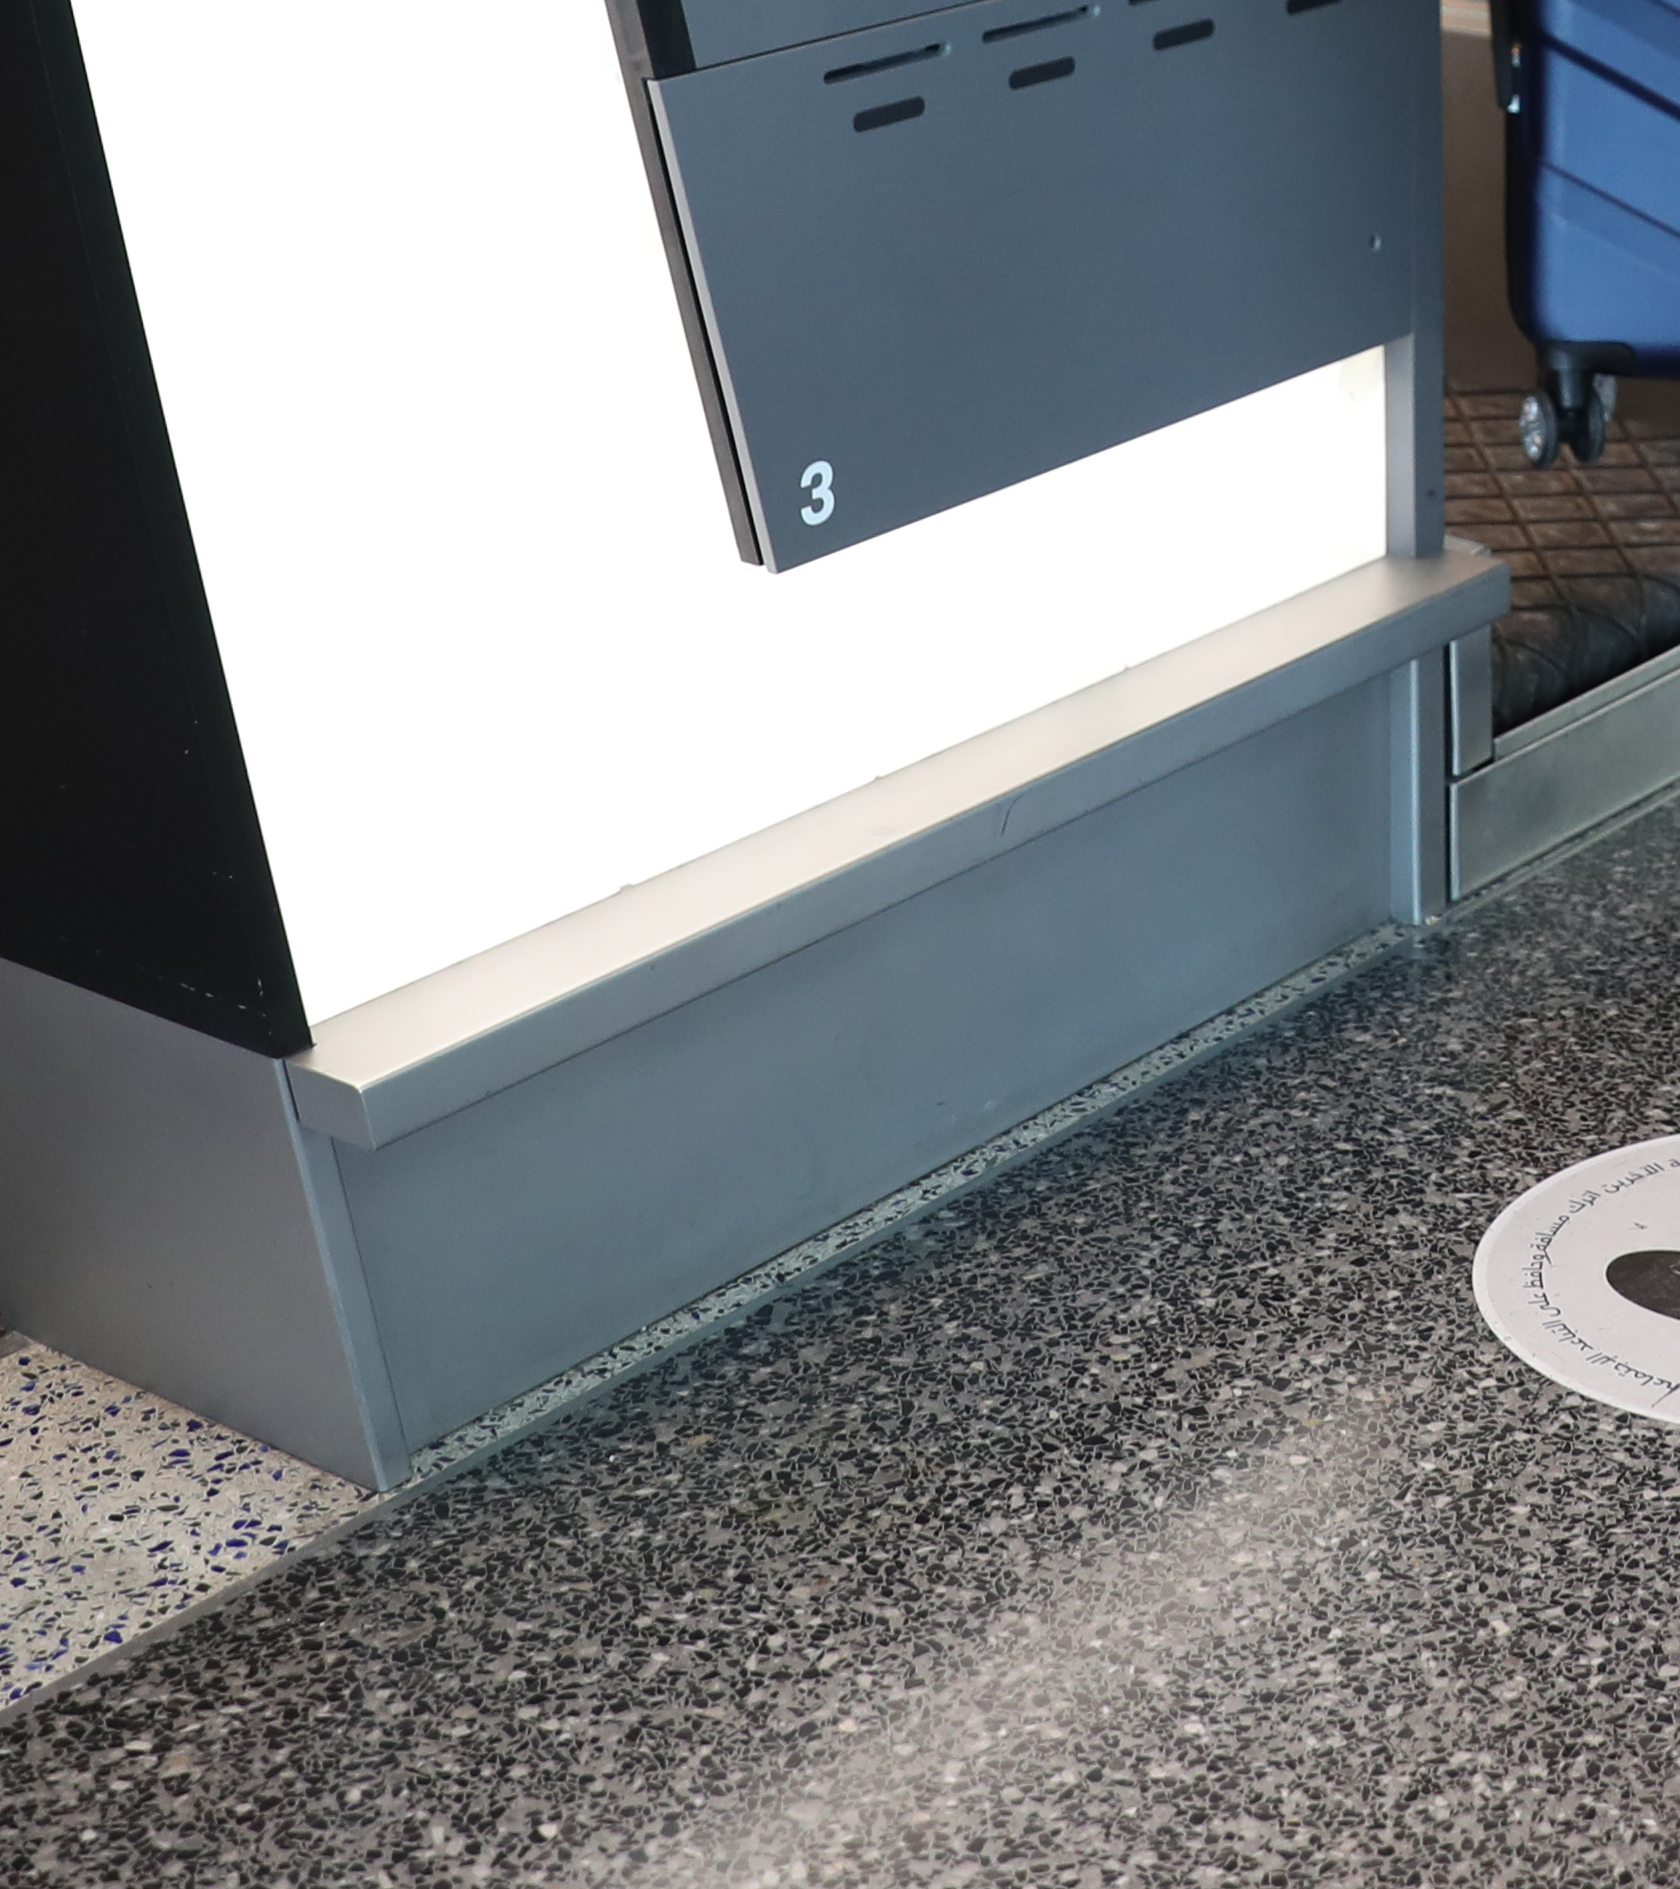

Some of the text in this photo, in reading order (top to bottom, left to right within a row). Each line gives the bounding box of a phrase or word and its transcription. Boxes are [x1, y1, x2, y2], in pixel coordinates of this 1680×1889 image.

[800, 460, 835, 526] 3
[1530, 1214, 1571, 1252] مسافة
[1521, 1249, 1551, 1290] وحافظ
[1528, 1291, 1562, 1317] على
[1541, 1319, 1594, 1351] التباعد
